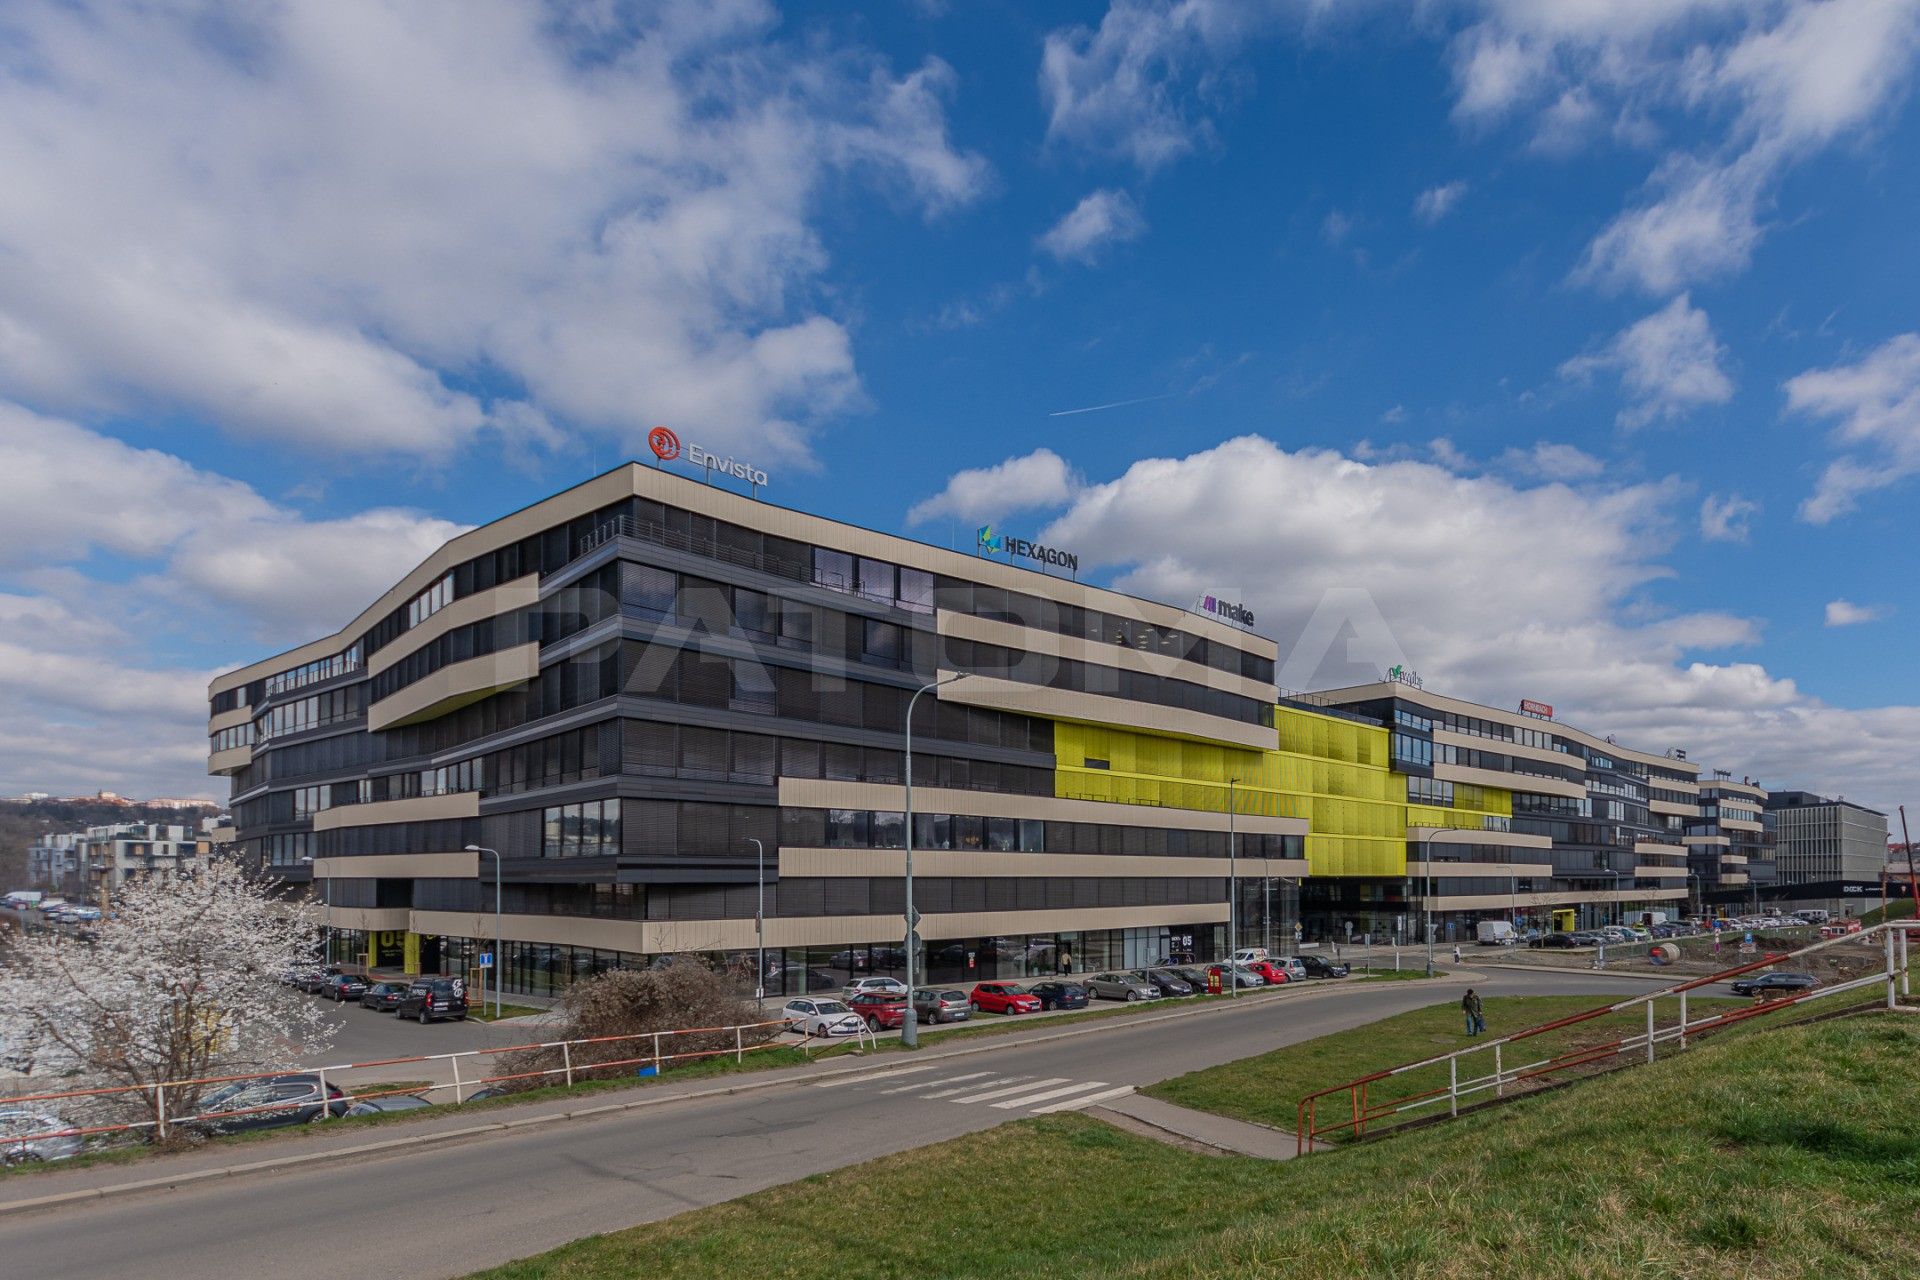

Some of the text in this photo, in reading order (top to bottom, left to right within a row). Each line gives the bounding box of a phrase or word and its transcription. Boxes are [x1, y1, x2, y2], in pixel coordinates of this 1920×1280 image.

[689, 442, 767, 486] Envista
[1005, 536, 1078, 570] HEXAGON
[1218, 600, 1254, 627] make
